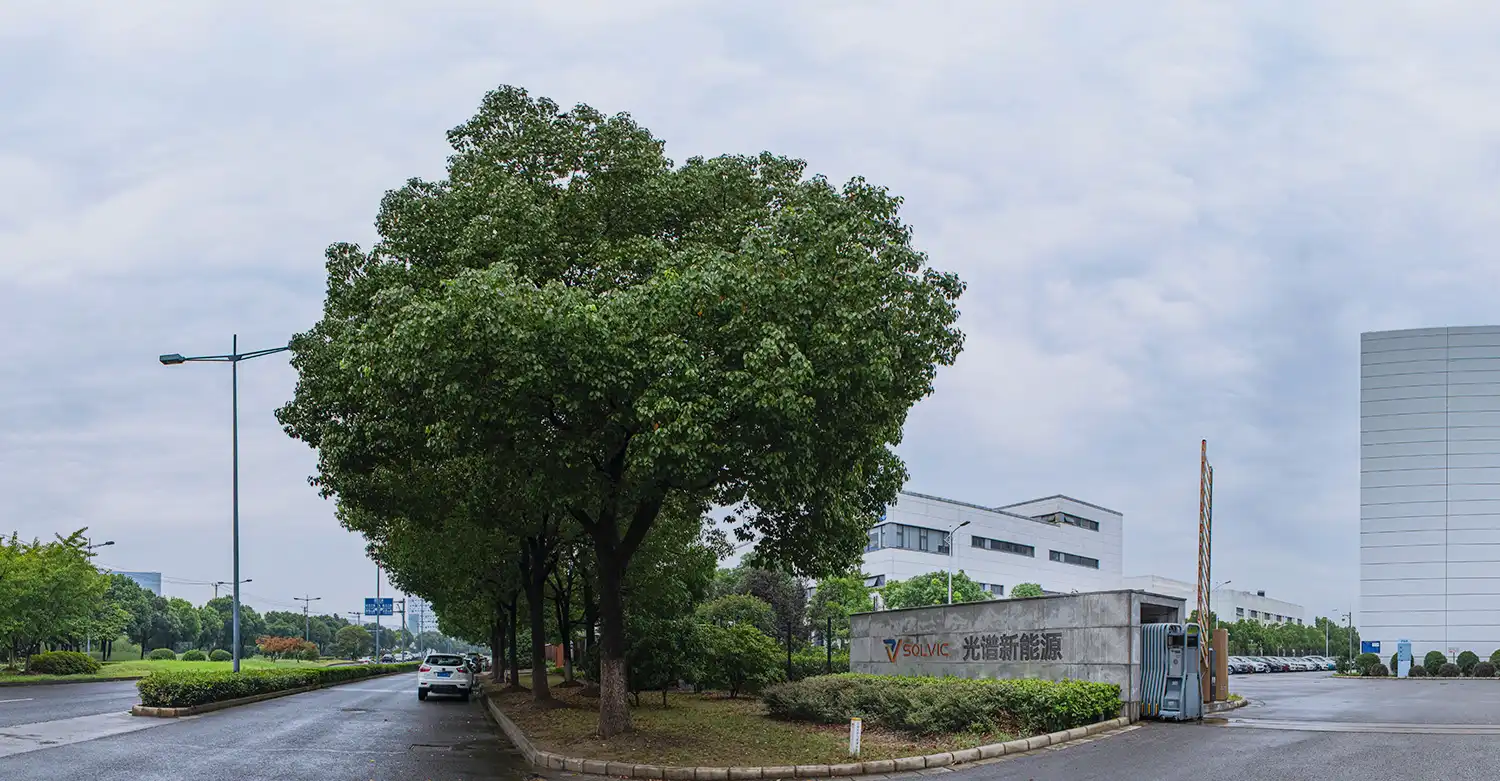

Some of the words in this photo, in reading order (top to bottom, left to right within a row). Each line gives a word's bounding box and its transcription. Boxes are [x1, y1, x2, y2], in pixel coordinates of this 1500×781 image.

[903, 643, 950, 657] SOLVIC
[963, 632, 1063, 662] 光谱新能源
